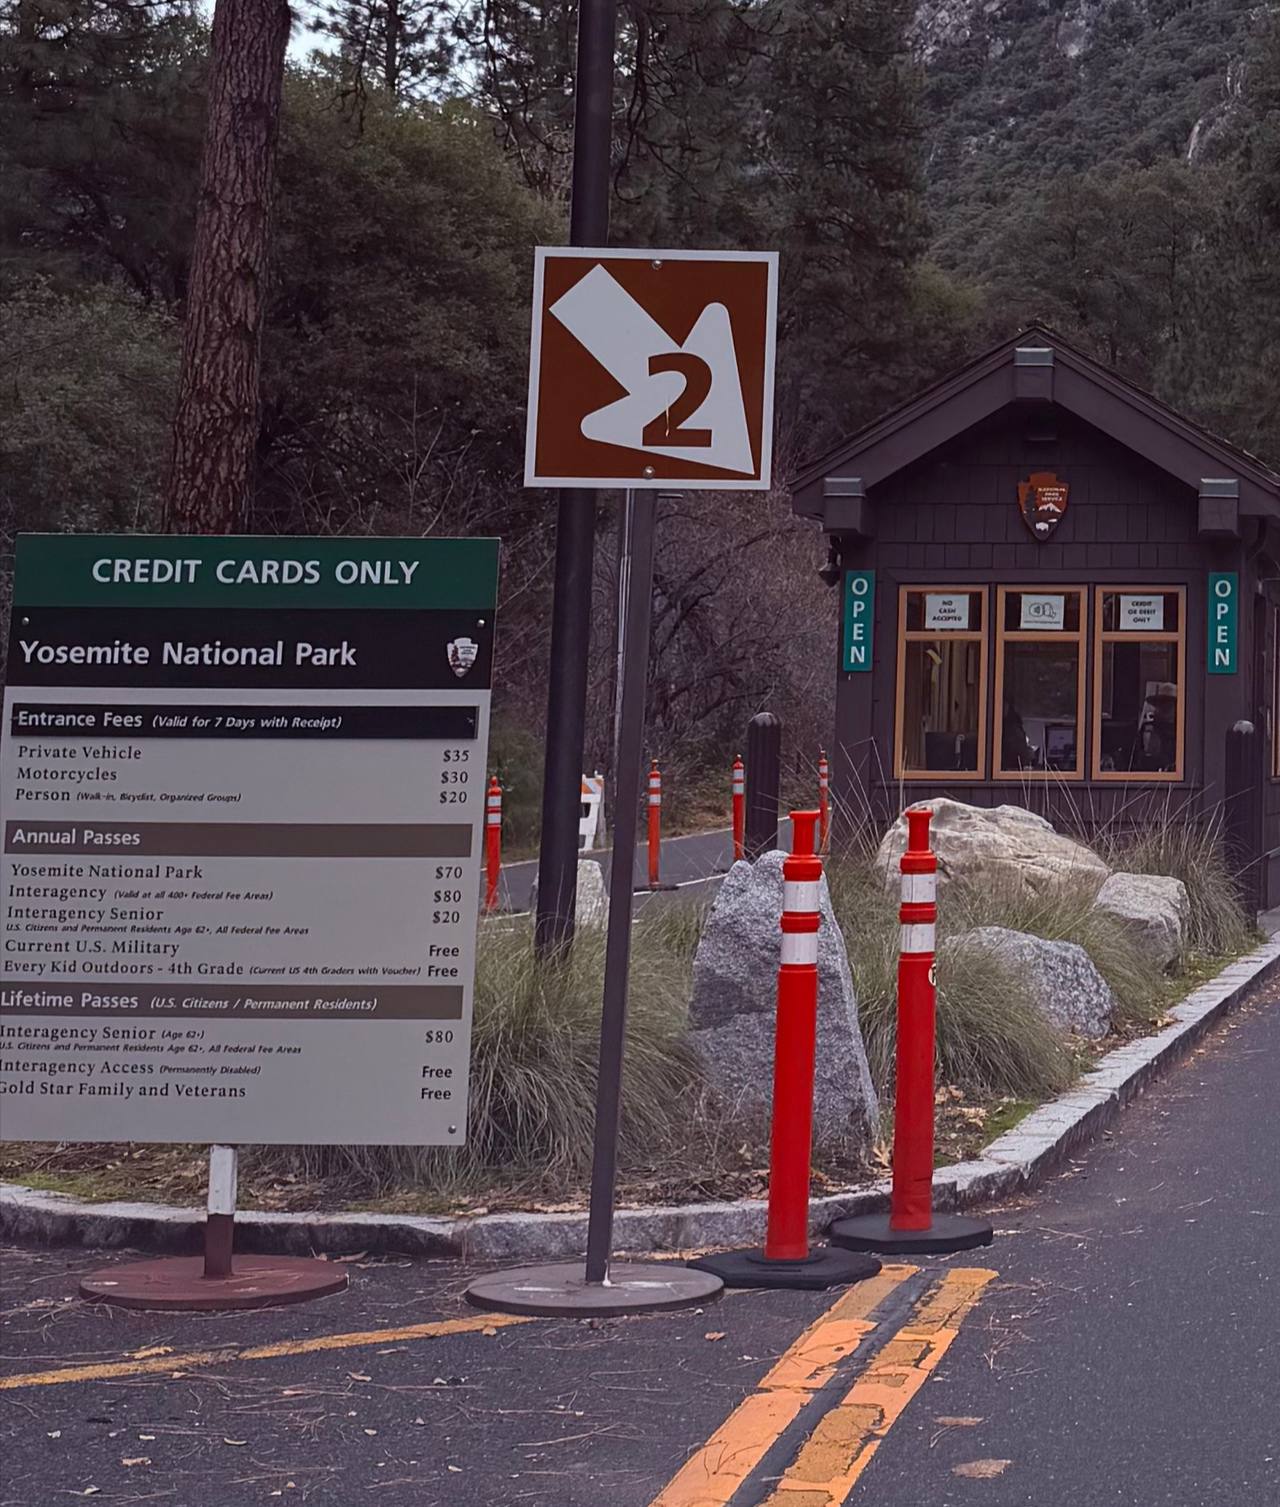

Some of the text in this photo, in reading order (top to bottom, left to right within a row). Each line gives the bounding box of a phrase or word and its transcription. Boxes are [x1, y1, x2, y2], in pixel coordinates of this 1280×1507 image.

[642, 352, 713, 448] 2
[92, 558, 420, 585] CREDIT CARDS ONLY
[850, 577, 869, 664] OPEN
[1215, 580, 1232, 666] OPEN
[19, 640, 357, 666] Yosemite National Park
[18, 711, 342, 731] Entrance Fees (Valid for 7 Days with Receipt)
[18, 745, 142, 760] Private Vehicle
[443, 750, 469, 763] $35
[17, 767, 118, 784] Motorcycles
[440, 771, 468, 784] $30
[16, 788, 70, 801] Person
[159, 793, 204, 804] Organized
[206, 793, 242, 803] Groups)
[439, 791, 467, 804] $20
[12, 828, 140, 846] Annual Passes
[11, 864, 203, 879] Yosemite National Park
[435, 866, 463, 879] $70
[9, 884, 107, 902] Interagency
[114, 890, 139, 900] (Valid
[142, 891, 151, 899] at
[155, 891, 165, 899] all
[191, 891, 223, 900] Federal
[225, 892, 241, 900] Fee
[243, 892, 274, 901] Areas)
[433, 890, 461, 903] $80
[7, 906, 164, 923] Interagency Senior
[433, 911, 460, 924] $20
[25, 923, 58, 932] Citizens
[62, 924, 78, 932] and
[81, 924, 127, 933] Permanent
[130, 925, 171, 934] Residents
[174, 926, 192, 935] Age
[216, 926, 228, 934] All
[231, 926, 263, 935] Federal
[265, 926, 280, 935] Fee
[283, 926, 310, 935] Areas
[5, 939, 180, 958] Current U.S. Military
[428, 944, 459, 957] Free
[4, 960, 46, 976] Every
[51, 960, 77, 973] Kid
[82, 961, 154, 974] Outdoors
[168, 962, 192, 974] 4th
[197, 962, 244, 975] Grade
[249, 966, 286, 975] (Current
[289, 966, 300, 975] US
[302, 966, 318, 975] 4th
[320, 967, 355, 976] Graders
[358, 967, 378, 975] with
[381, 966, 421, 976] Voucher)
[427, 965, 459, 978] Free
[1, 990, 378, 1011] Lifetime Passes (U.S. Citizens / Permanent Residents)
[0, 1025, 98, 1042] Interagency
[102, 1026, 157, 1040] Senior
[161, 1030, 183, 1040] (Age
[425, 1030, 454, 1044] $80
[17, 1042, 51, 1051] Citizens
[54, 1043, 70, 1051] and
[73, 1043, 120, 1052] Permanent
[122, 1044, 164, 1053] Residents
[167, 1044, 185, 1054] Age
[208, 1045, 221, 1053] All
[223, 1045, 255, 1053] Federal
[258, 1046, 273, 1054] Fee
[276, 1046, 302, 1054] Areas
[101, 1061, 154, 1074] Access
[159, 1065, 218, 1076] (Permanently
[220, 1066, 262, 1075] Disabled)
[422, 1066, 453, 1078] Free
[0, 1080, 246, 1100] Gold Star Family and Veterans
[421, 1087, 452, 1100] Free
